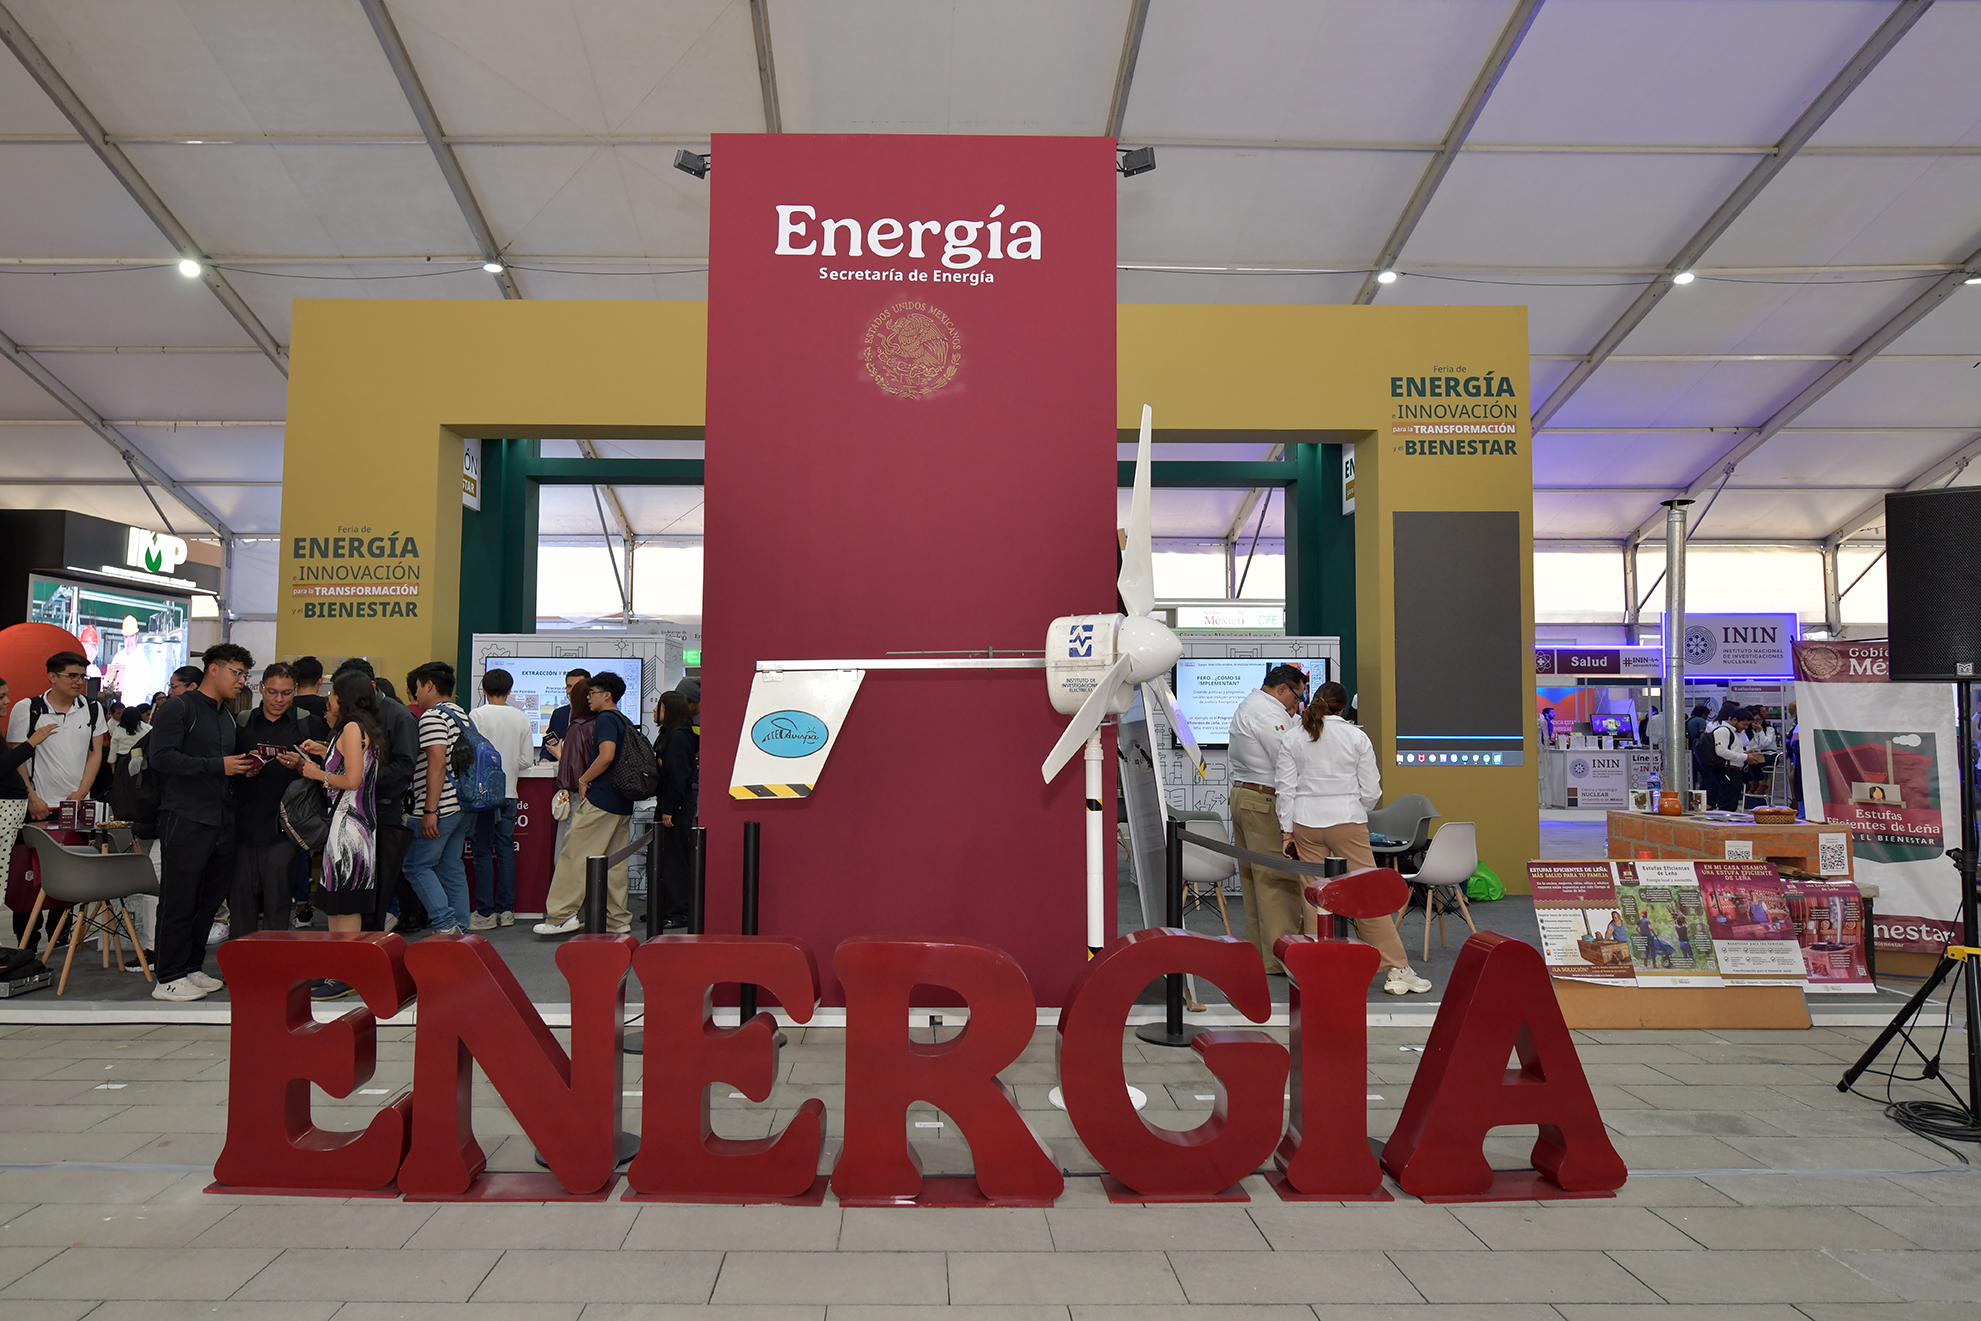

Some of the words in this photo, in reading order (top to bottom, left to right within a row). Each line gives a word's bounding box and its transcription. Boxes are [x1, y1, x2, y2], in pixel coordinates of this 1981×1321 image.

[774, 204, 1042, 269] Energía
[819, 267, 903, 281] Secretaría
[908, 269, 928, 282] de
[933, 269, 995, 286] Energía
[864, 309, 891, 344] ESTADOS
[892, 301, 927, 313] UNIDOS
[928, 306, 961, 350] MEXICANOS
[1391, 371, 1515, 397] ENERGÍA
[1398, 400, 1517, 419] INNOVACIÓN
[1414, 423, 1515, 433] TRANSFORMACIÓN
[1405, 440, 1517, 455] BIENESTAR
[127, 527, 188, 573] IMP
[293, 531, 420, 558] ENERGÍA
[299, 561, 420, 580] INNOVACIÓN
[315, 584, 418, 595] TRANSFORMACIÓN
[304, 602, 418, 618] BIENESTAR
[1204, 615, 1244, 625] México
[1258, 615, 1277, 625] CFE
[1722, 627, 1777, 643] ININ
[1849, 648, 1889, 657] Gobi
[1571, 656, 1607, 667] Salud
[1592, 759, 1620, 768] ININ
[516, 801, 528, 810] de
[1856, 809, 1902, 820] Estufas
[1891, 822, 1905, 831] de
[1908, 823, 1940, 834] Leña
[1878, 834, 1934, 844] BIENESTAR
[1873, 924, 1955, 944] nestar
[214, 869, 1625, 1200] ENERGÍA
